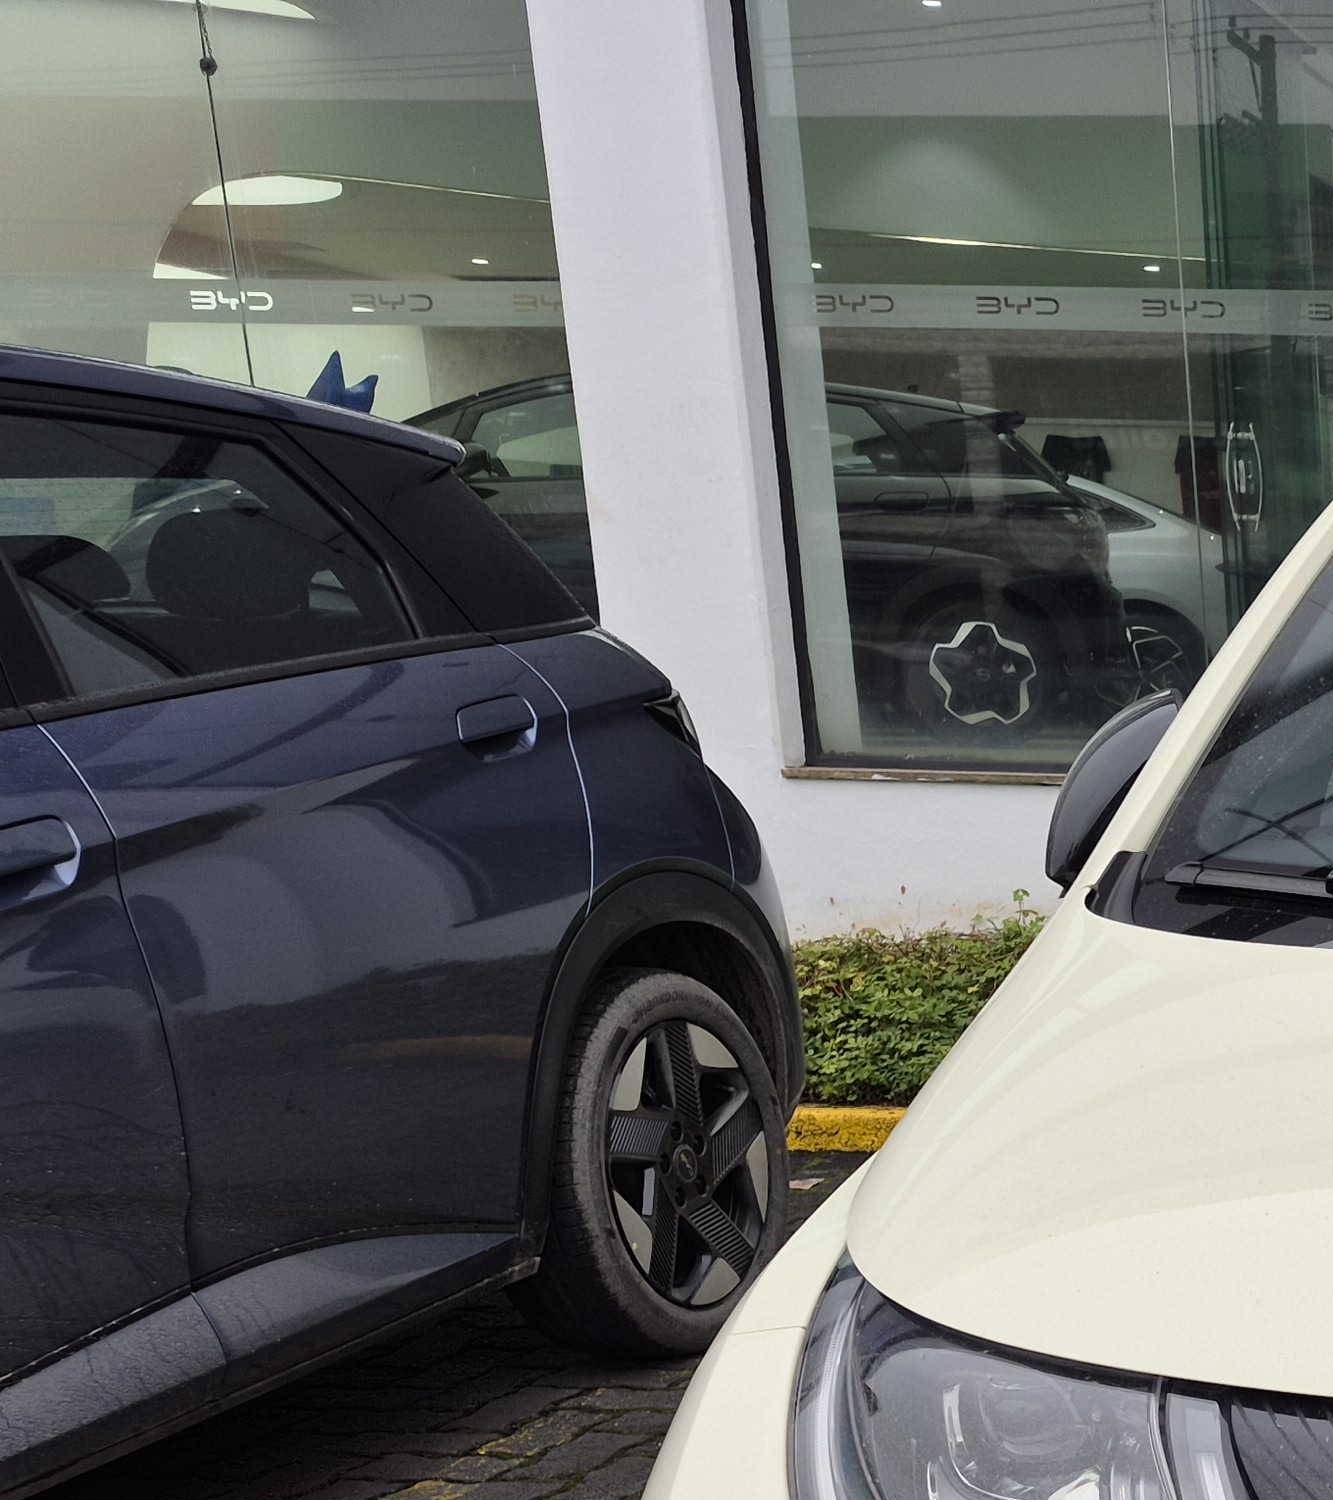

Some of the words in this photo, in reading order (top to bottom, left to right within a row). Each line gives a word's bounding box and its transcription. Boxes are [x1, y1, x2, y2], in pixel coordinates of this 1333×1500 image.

[189, 290, 274, 311] BYD
[351, 293, 433, 313] BYD
[815, 294, 894, 313] BYD
[975, 296, 1060, 315] BYD
[1142, 299, 1226, 318] BYD
